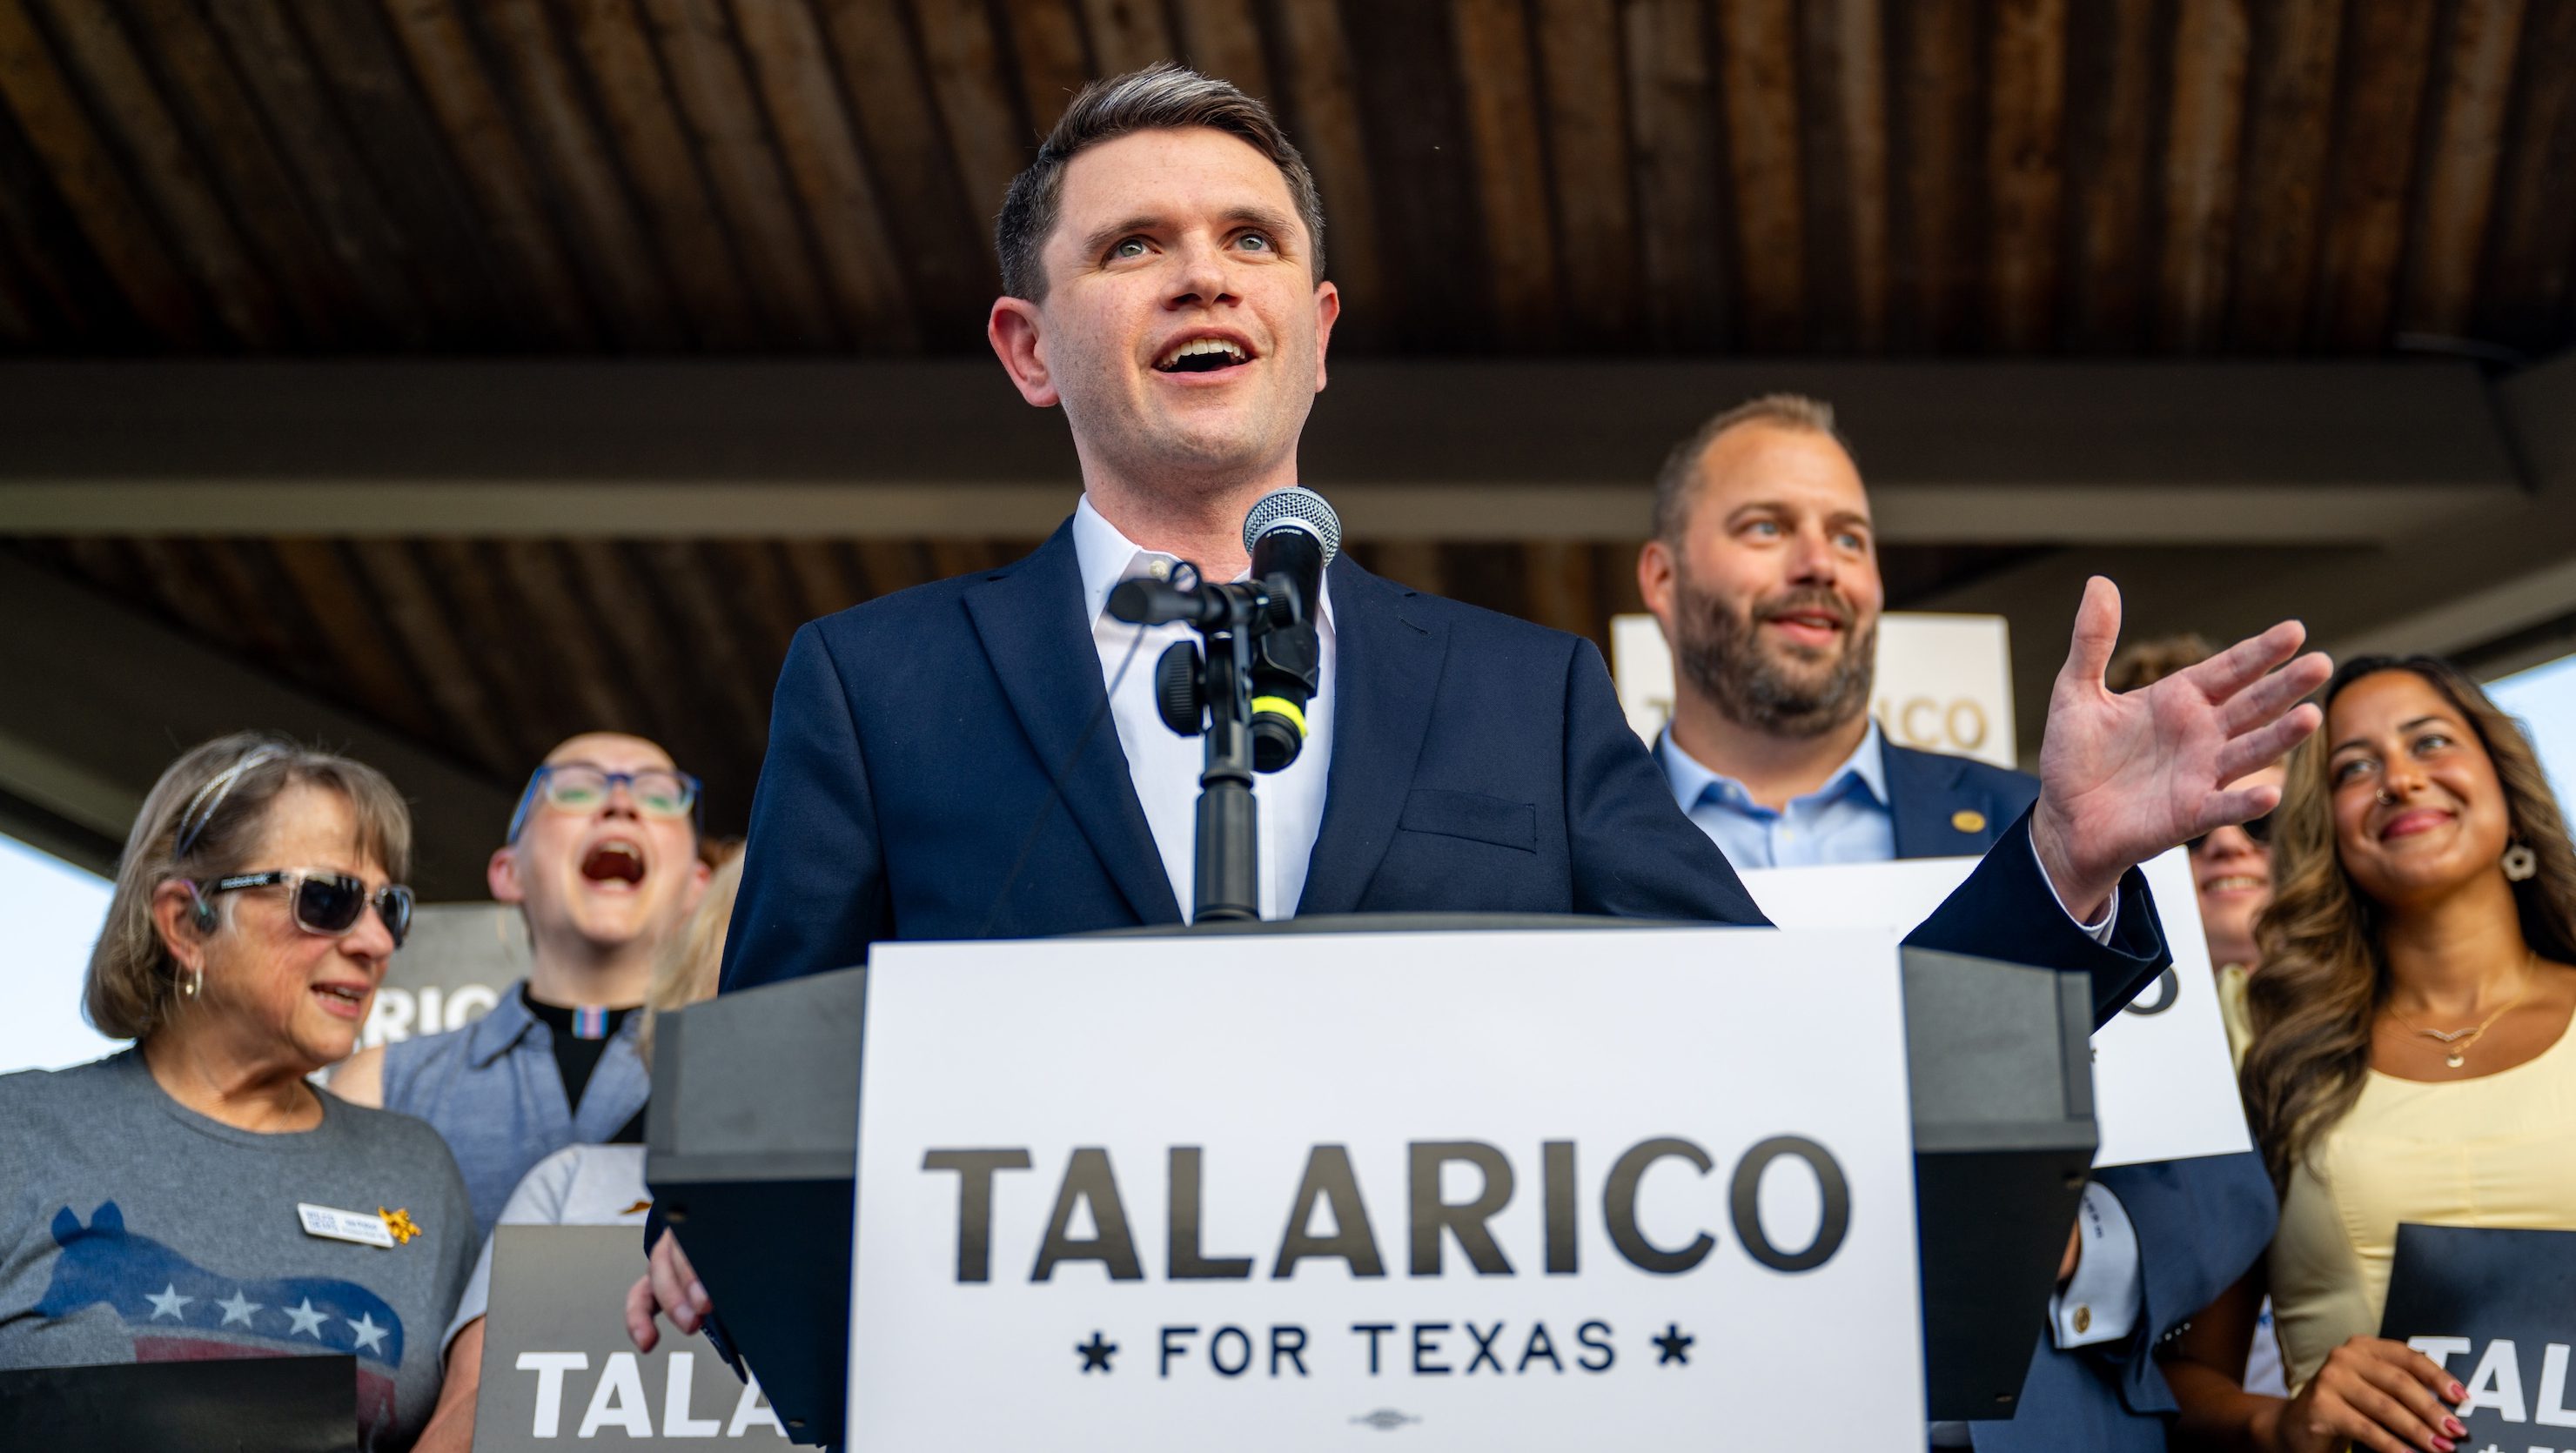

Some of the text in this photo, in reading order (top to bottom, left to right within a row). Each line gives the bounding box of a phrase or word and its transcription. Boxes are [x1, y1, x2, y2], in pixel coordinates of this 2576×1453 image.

[920, 1134, 1854, 1285] TALARICO
[1157, 1318, 1618, 1380] FOR TEXAS
[2406, 1336, 2576, 1429] TAL
